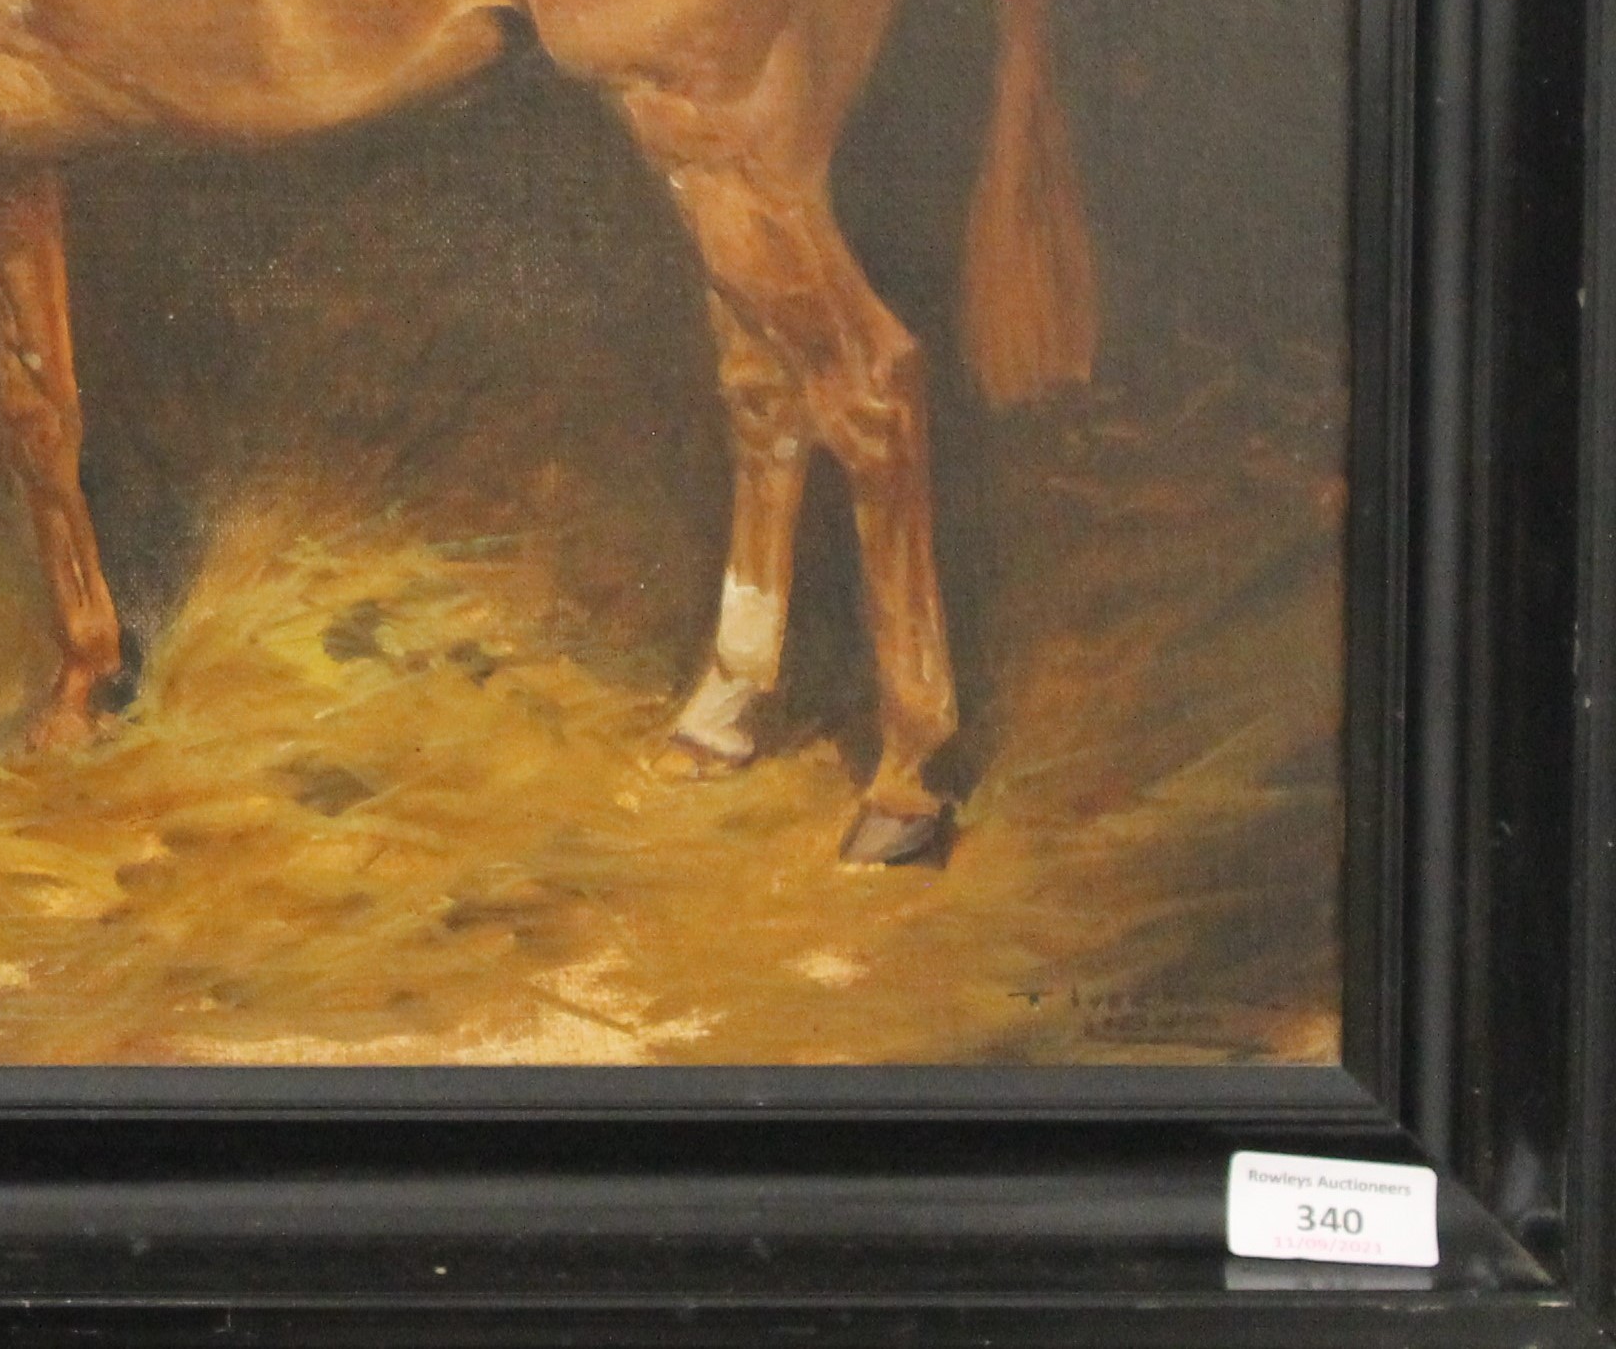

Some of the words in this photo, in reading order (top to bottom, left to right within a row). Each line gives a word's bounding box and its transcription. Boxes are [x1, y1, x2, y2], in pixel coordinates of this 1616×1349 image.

[1248, 1169, 1312, 1188] Rowleys
[1316, 1175, 1412, 1197] Auctioneers
[1296, 1204, 1363, 1235] 340
